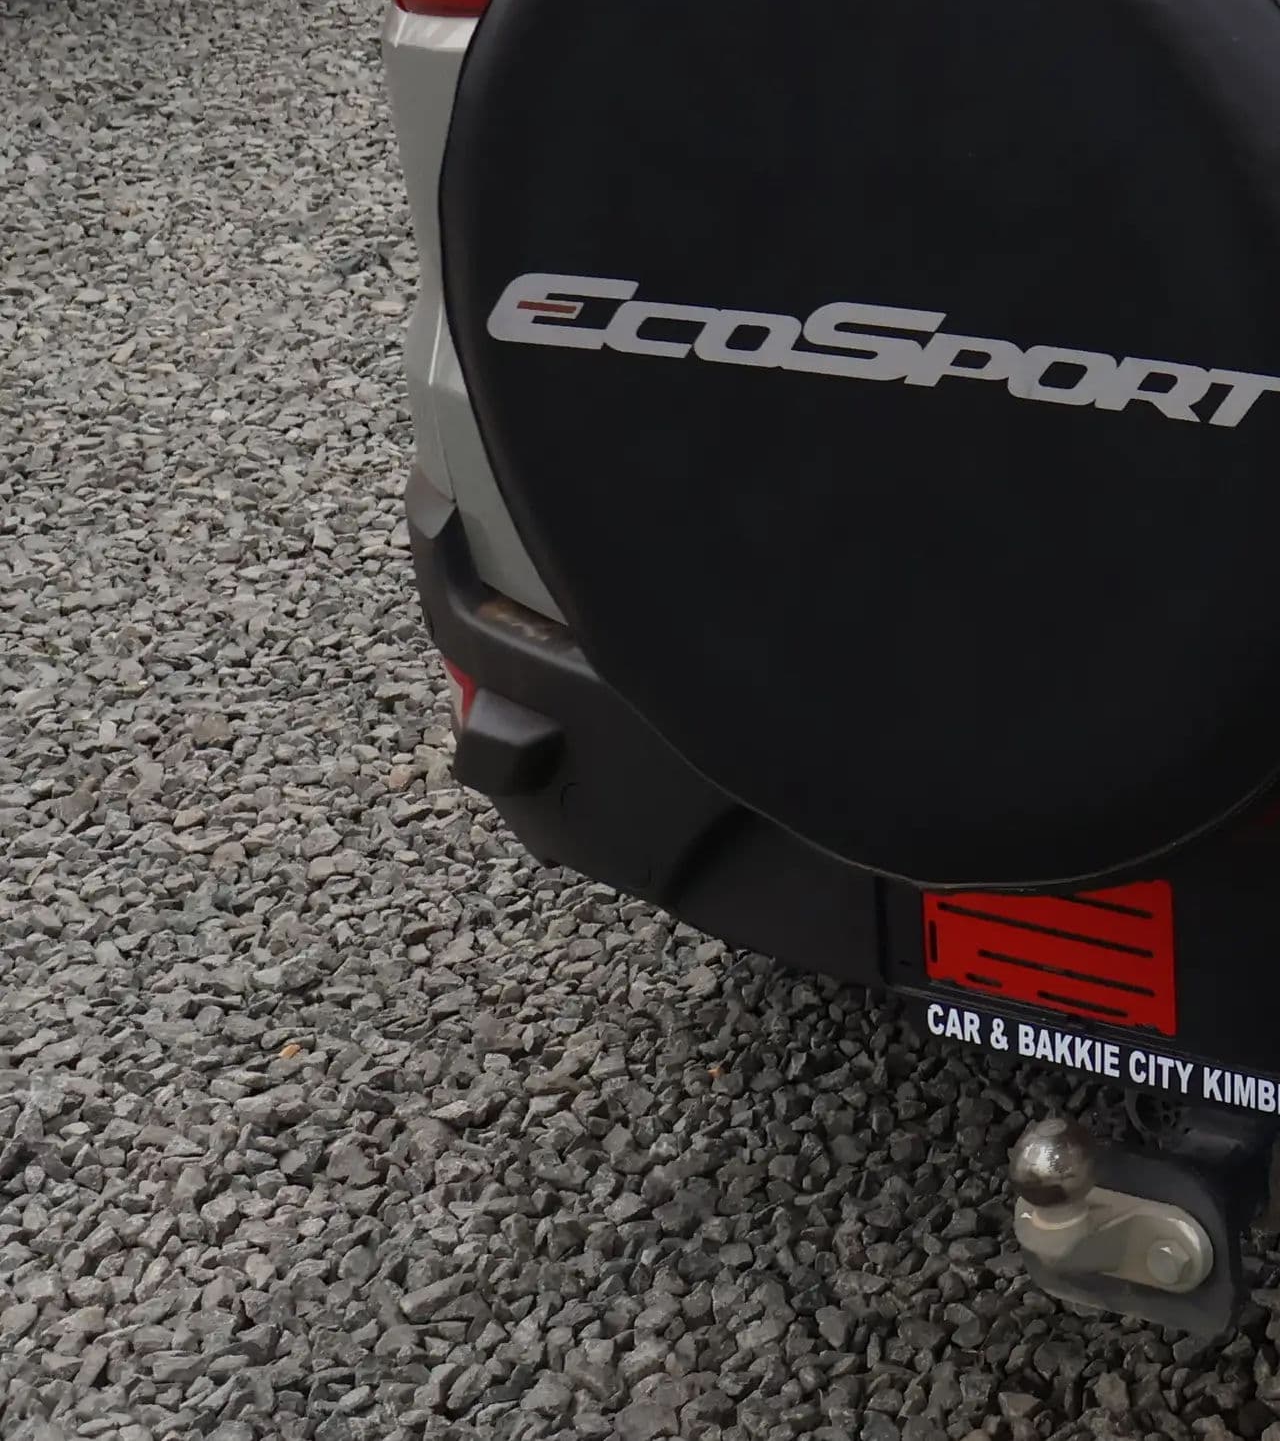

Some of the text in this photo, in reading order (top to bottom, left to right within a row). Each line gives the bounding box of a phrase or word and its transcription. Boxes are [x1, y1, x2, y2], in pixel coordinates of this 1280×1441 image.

[927, 1002, 982, 1046] CAR
[990, 1018, 1009, 1052] &
[1018, 1023, 1121, 1078] BAKKIE
[1129, 1050, 1194, 1094] CITY
